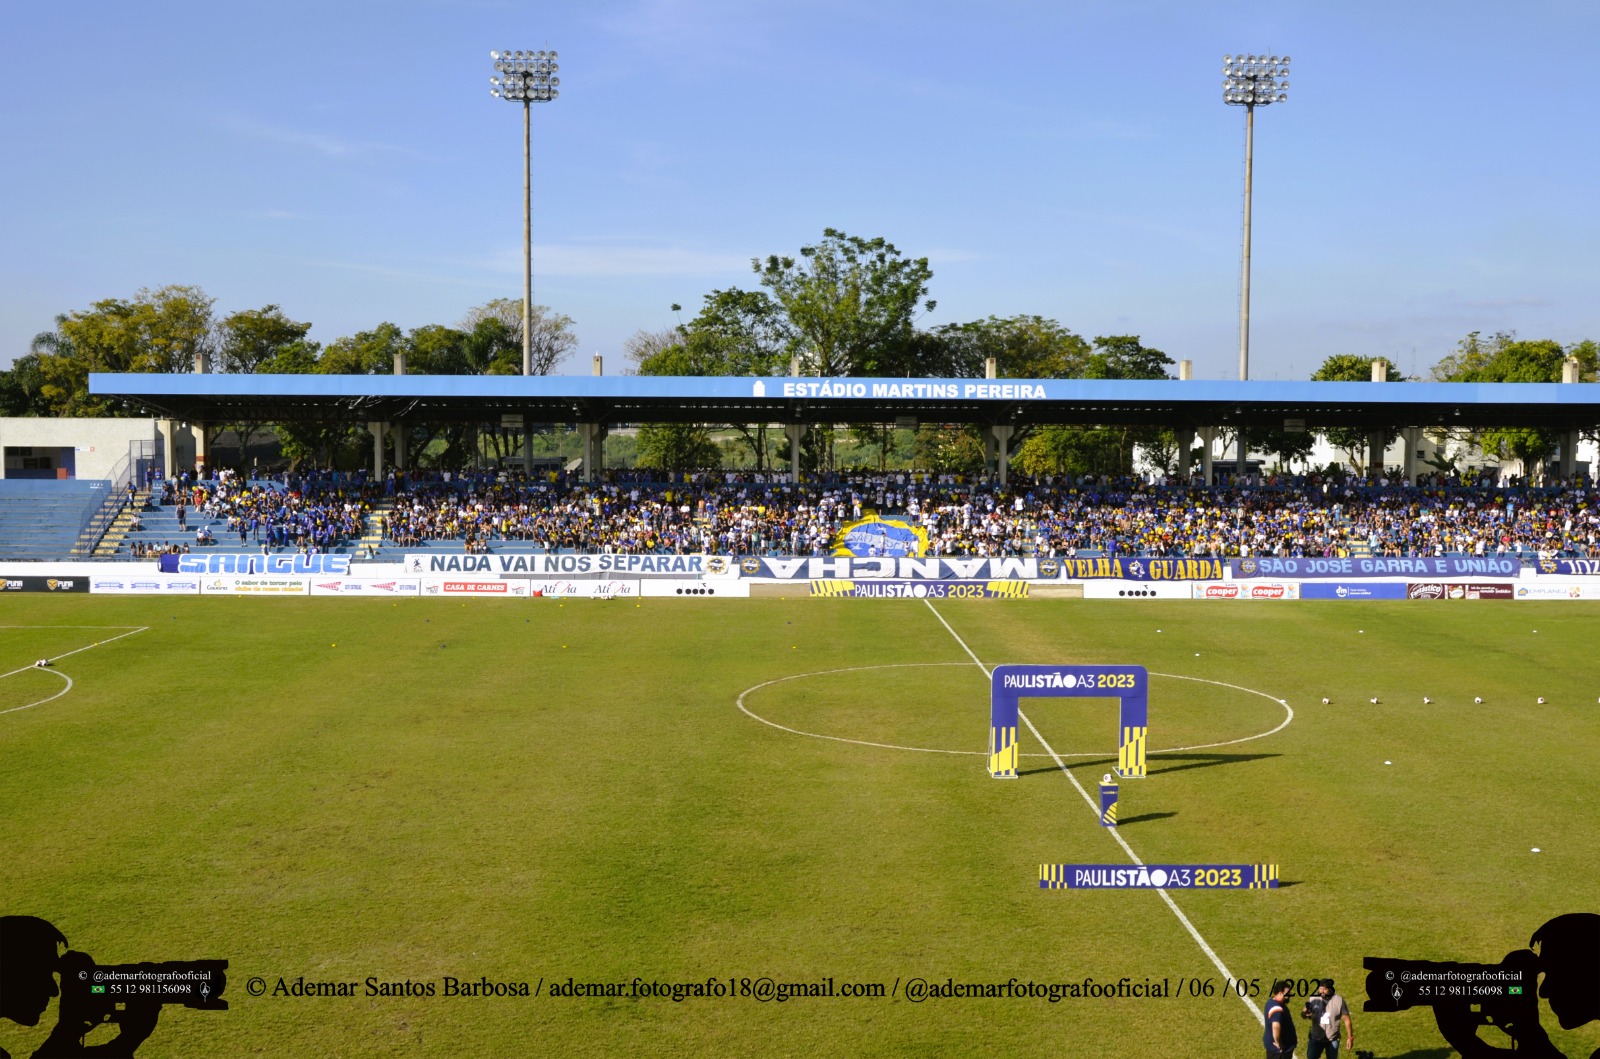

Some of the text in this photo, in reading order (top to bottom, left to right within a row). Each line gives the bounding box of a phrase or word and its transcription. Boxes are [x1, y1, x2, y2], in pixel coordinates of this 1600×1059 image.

[784, 380, 1046, 399] ESTÁDIO MARTINS PEREIRA
[178, 554, 353, 575] SANGUE
[430, 554, 702, 573] NADA VAI NOS SEPARAR
[1064, 558, 1222, 580] VELHA GUARDA
[1259, 558, 1513, 573] SÃO JOSÉ GARRA E UNIÃO
[948, 585, 984, 598] 2023
[1207, 588, 1237, 596] cooper
[1253, 588, 1283, 596] cooper
[1097, 674, 1135, 688] 2023
[1194, 869, 1242, 887] 2023
